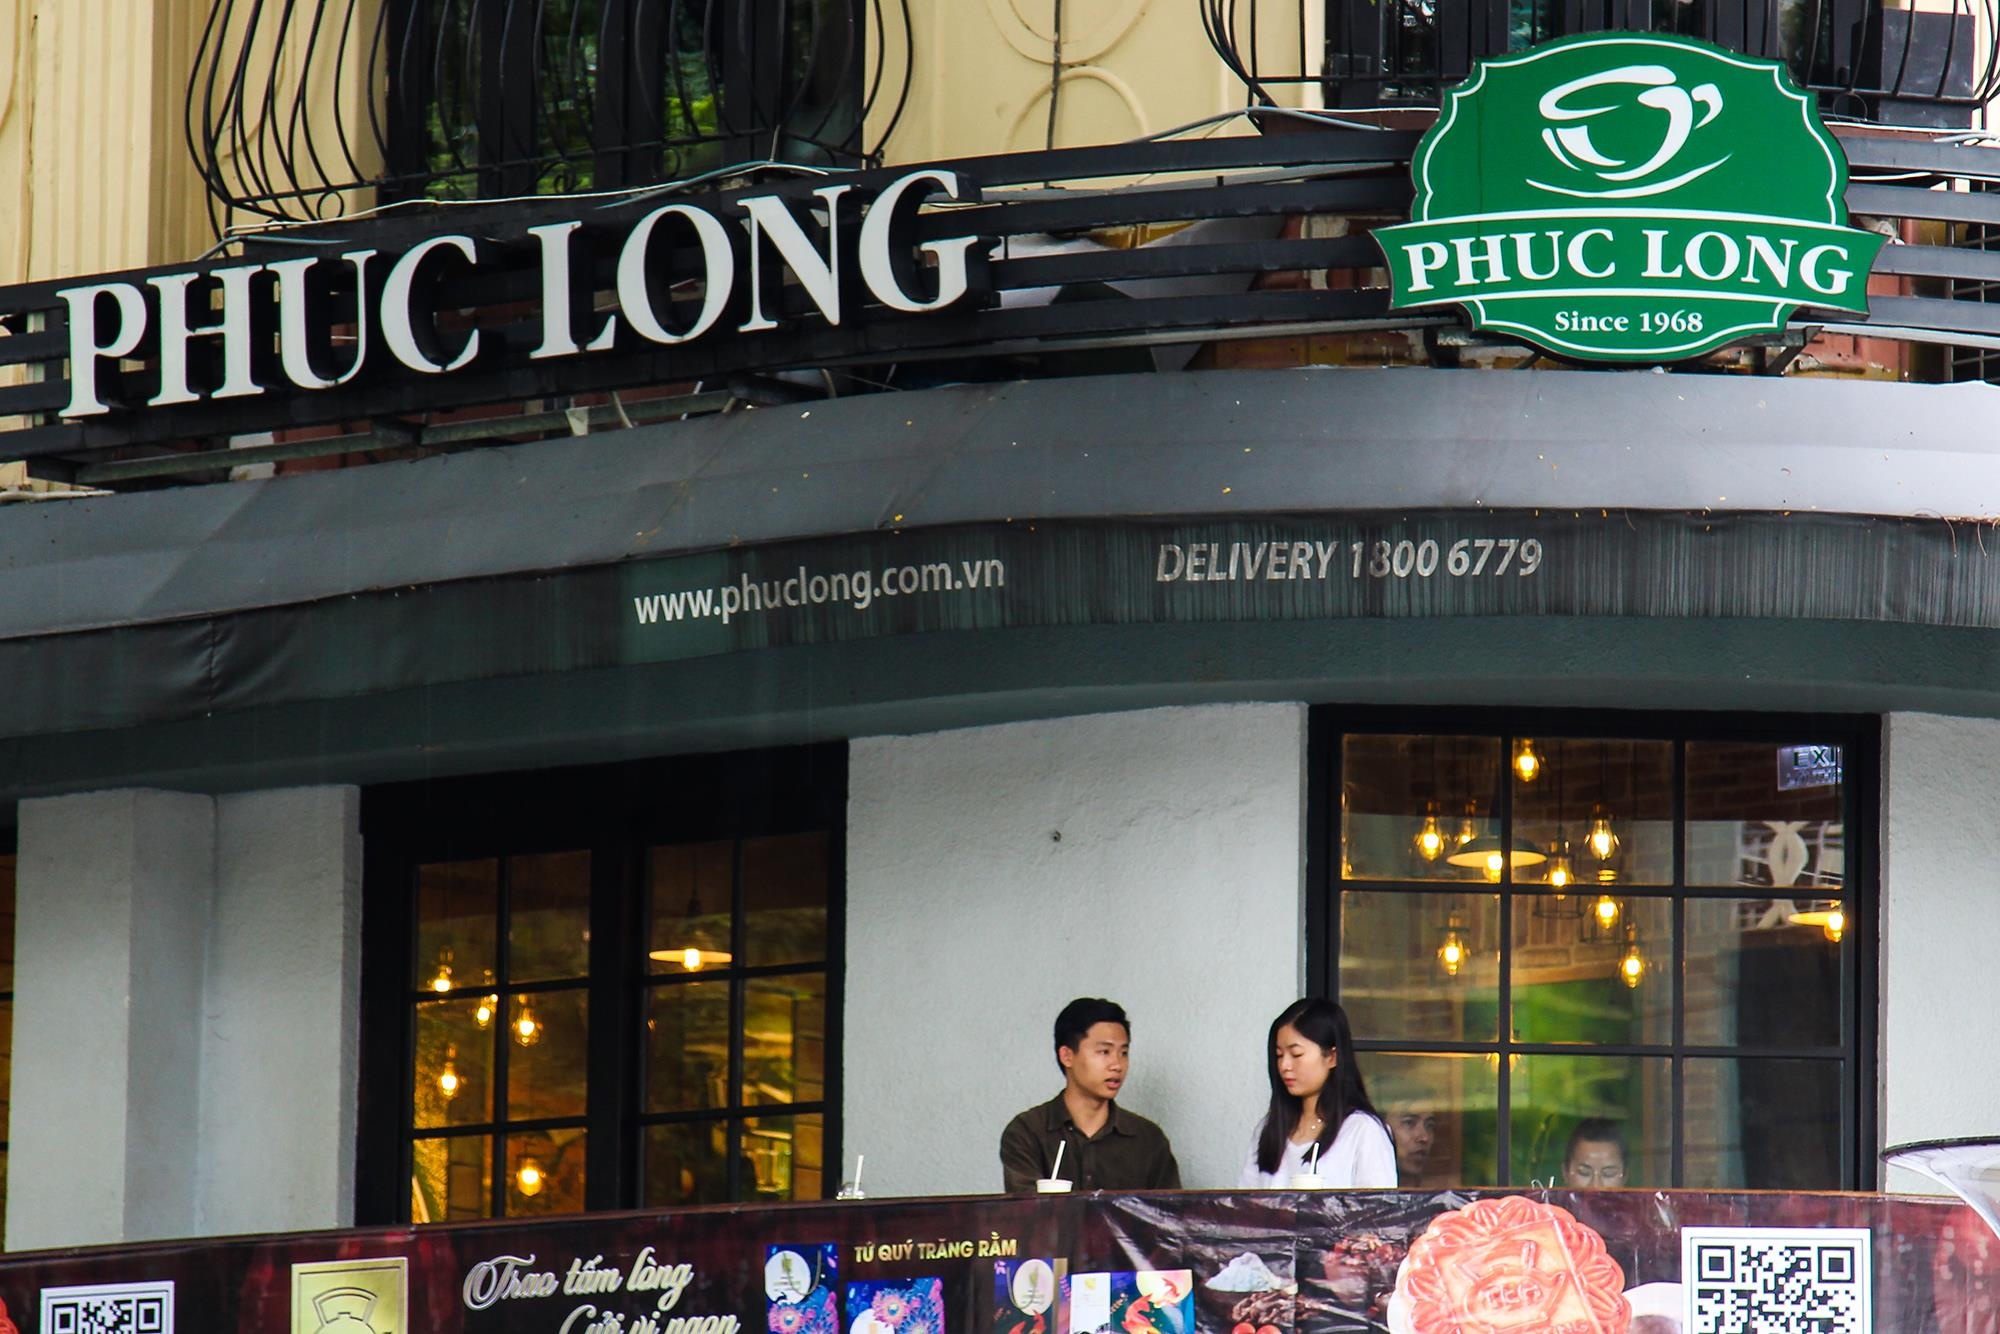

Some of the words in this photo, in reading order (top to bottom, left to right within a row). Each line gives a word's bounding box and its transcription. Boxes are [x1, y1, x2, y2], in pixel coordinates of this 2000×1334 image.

[1401, 228, 1616, 293] PHUC
[1641, 229, 1855, 296] LONG
[56, 234, 479, 417] PHUC
[528, 170, 979, 359] LONG
[1555, 310, 1629, 332] Since
[1640, 310, 1703, 335] 1968
[1156, 540, 1338, 582] DELIVERY
[1352, 538, 1440, 579] 1800
[1446, 538, 1543, 577] 6779
[633, 558, 1004, 625] www.phuclong.com.vn
[1793, 745, 1842, 768] EXI
[877, 1239, 914, 1262] QUÝ
[917, 1238, 975, 1260] TRĂNG
[977, 1231, 1017, 1258] RẰM
[462, 1253, 559, 1310] Trao
[626, 1246, 696, 1312] lòng
